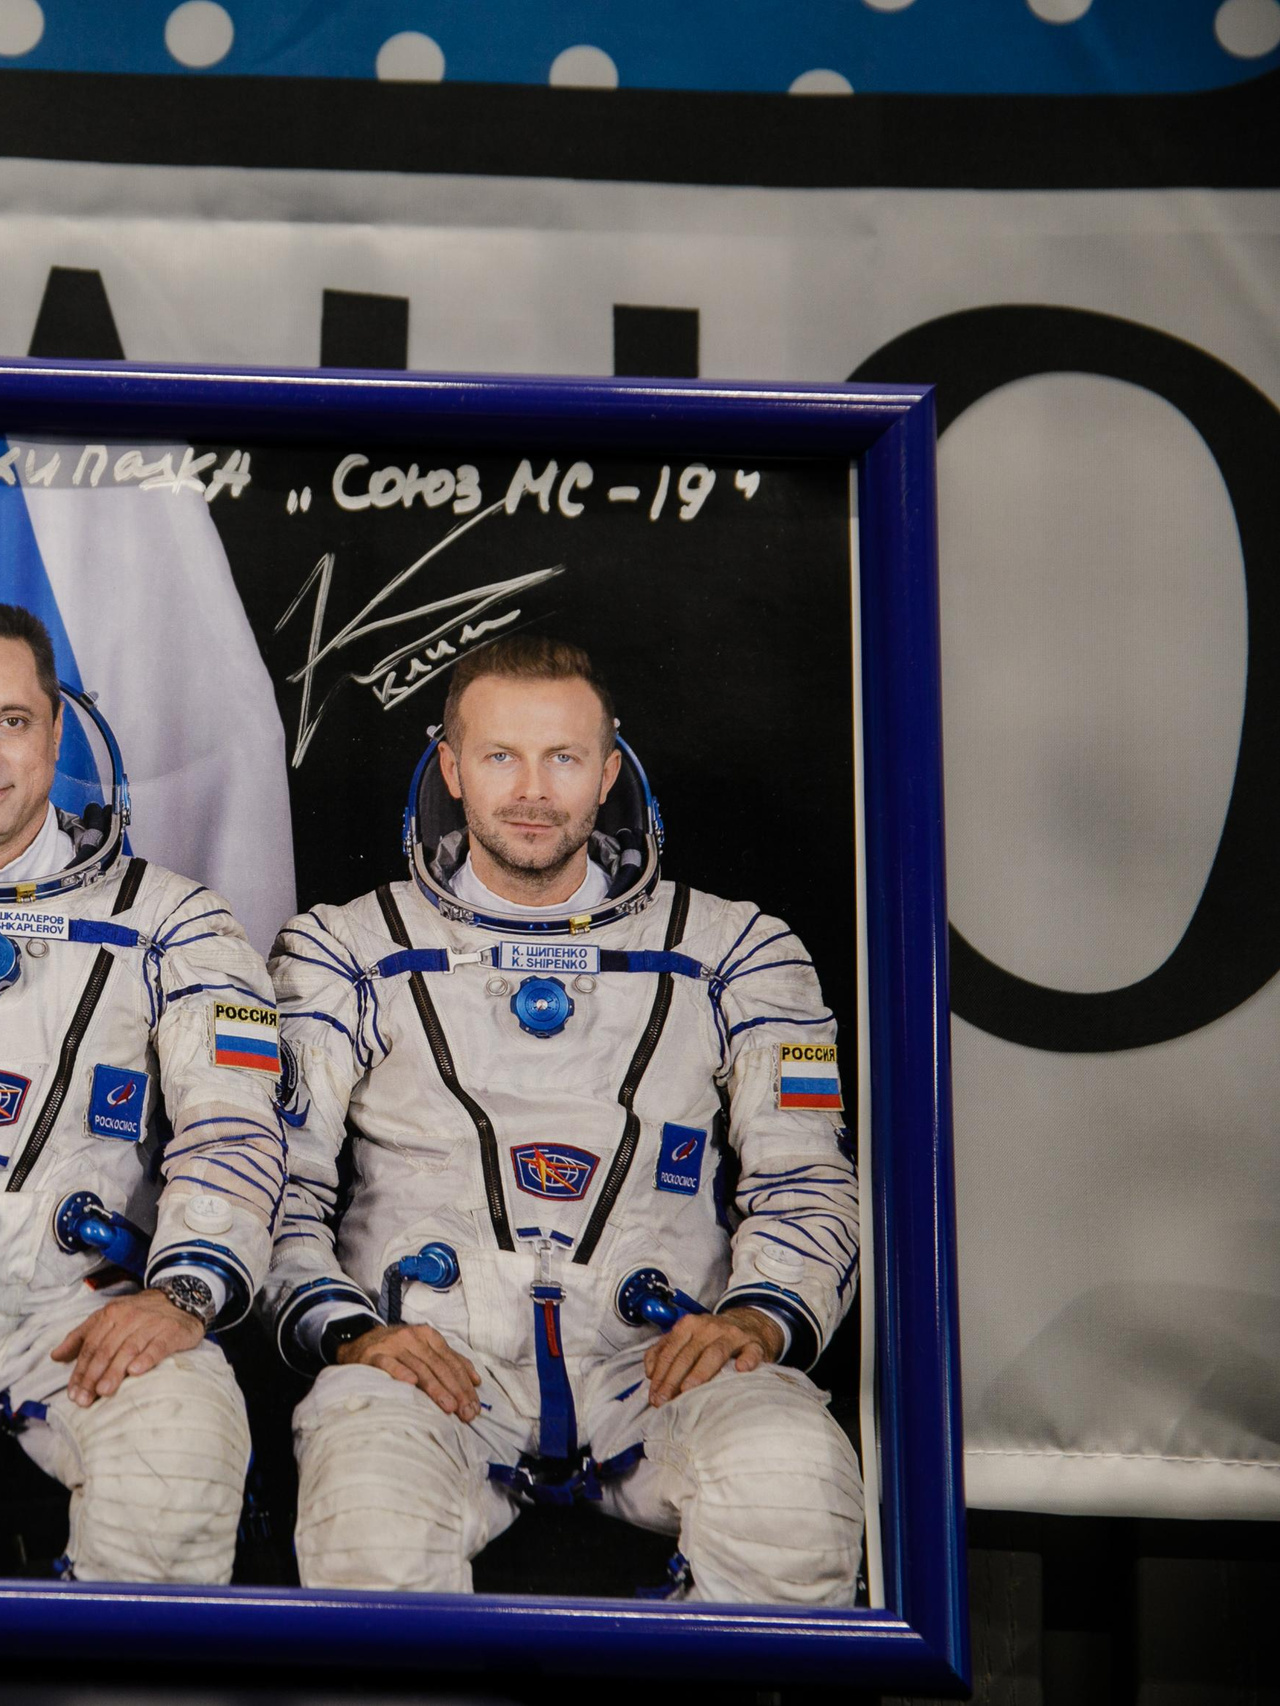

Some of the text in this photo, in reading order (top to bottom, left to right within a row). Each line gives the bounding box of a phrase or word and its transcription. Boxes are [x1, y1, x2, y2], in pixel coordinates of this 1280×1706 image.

[512, 945, 588, 958] К. ШИПЕНКО
[511, 956, 588, 970] K. SHIPENKO
[215, 1004, 277, 1027] РОССИЯ
[781, 1046, 836, 1061] РОССИЯ
[94, 1114, 138, 1133] РОСКОСМОС
[660, 1171, 698, 1188] РОСКОСМОС
